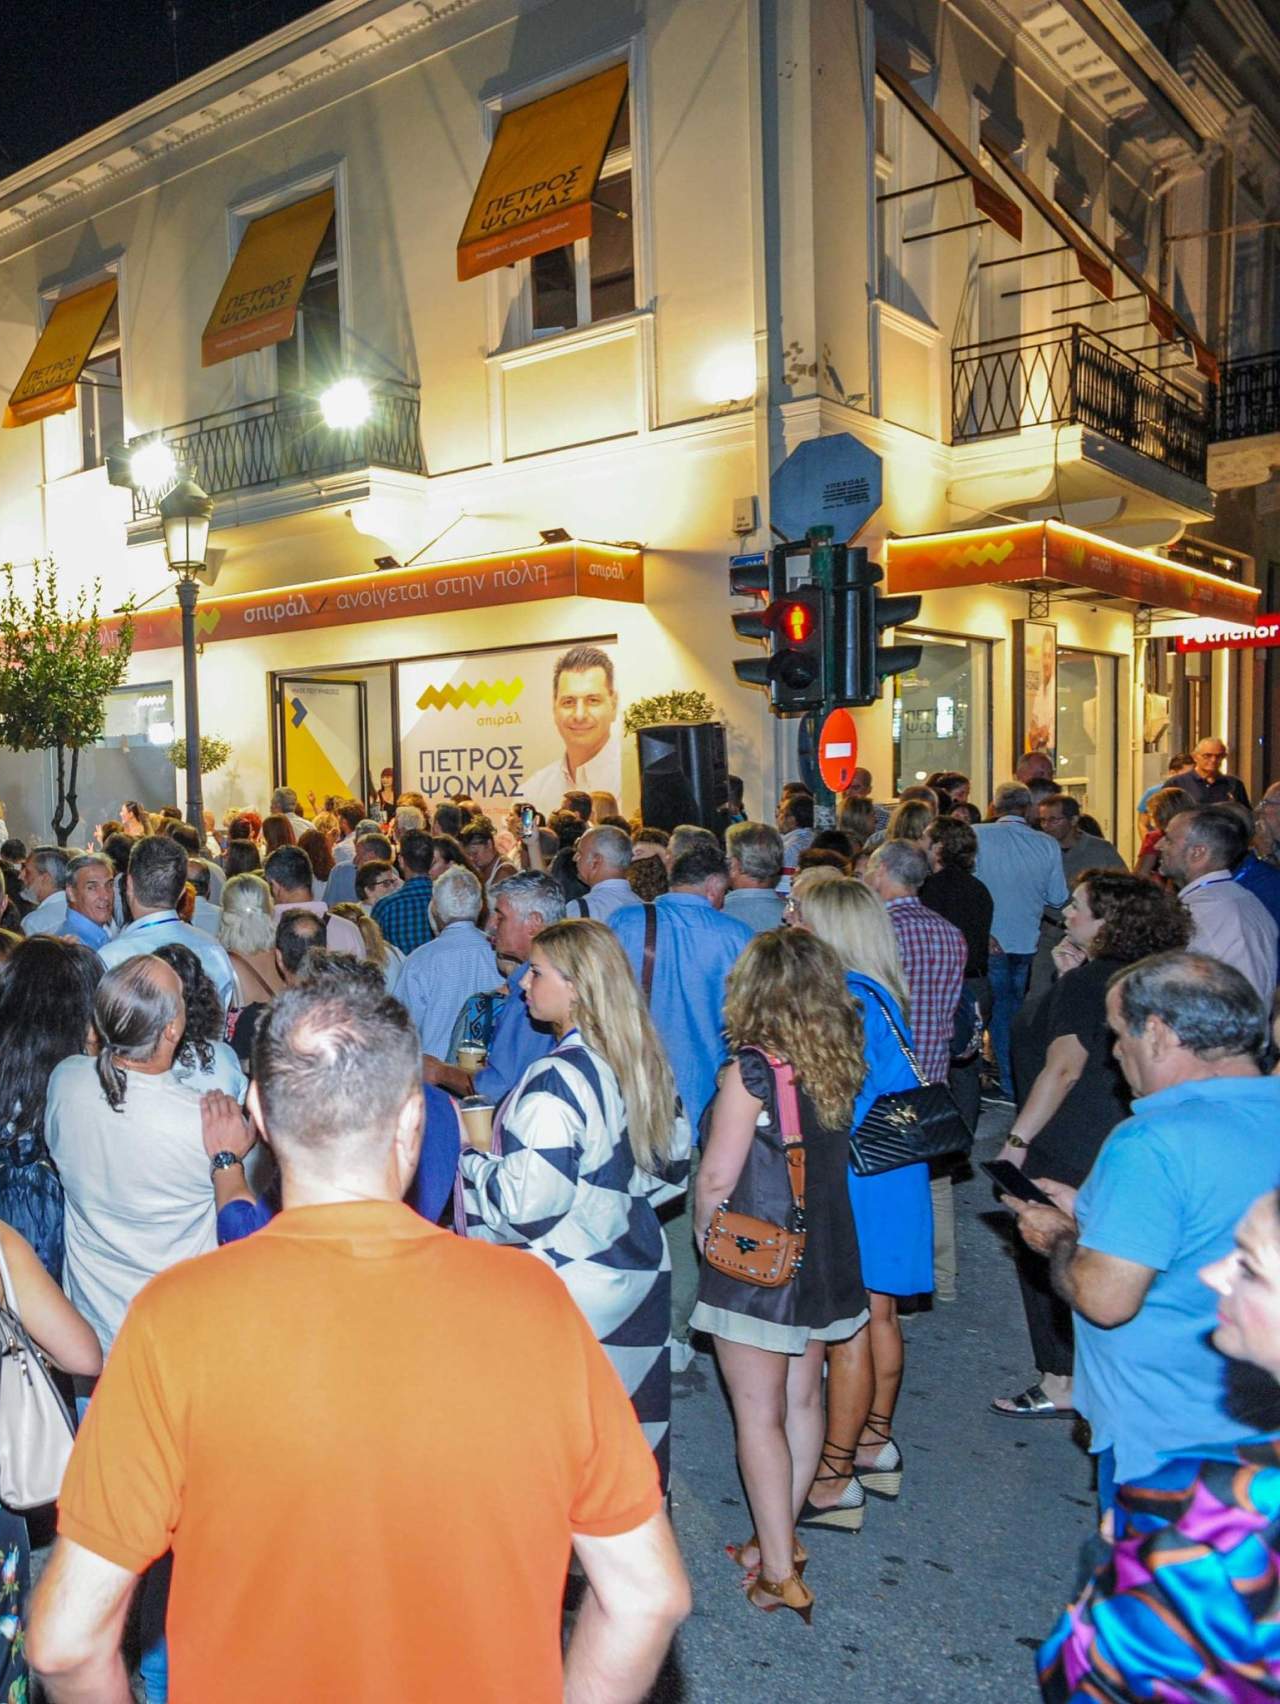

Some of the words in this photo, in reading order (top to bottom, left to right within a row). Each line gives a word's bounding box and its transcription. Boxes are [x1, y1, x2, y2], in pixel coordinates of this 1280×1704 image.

[485, 165, 582, 215] ΠΕΤΡΟΣ
[480, 186, 573, 231] ΨΩΜΑΣ
[221, 290, 291, 324] ΨΩΜΑΣ
[225, 274, 297, 313] ΠΕΤΡΟΣ
[589, 561, 625, 581] σπιράλ
[243, 593, 312, 624] σπιράλ
[336, 581, 429, 610] ανοίγεται
[435, 573, 486, 597] στην
[493, 559, 549, 588] πόλη
[476, 711, 522, 728] σπιράλ
[419, 745, 524, 773] ΠΕΤΡΟΣ
[420, 773, 524, 799] ΨΩΜΑΣ
